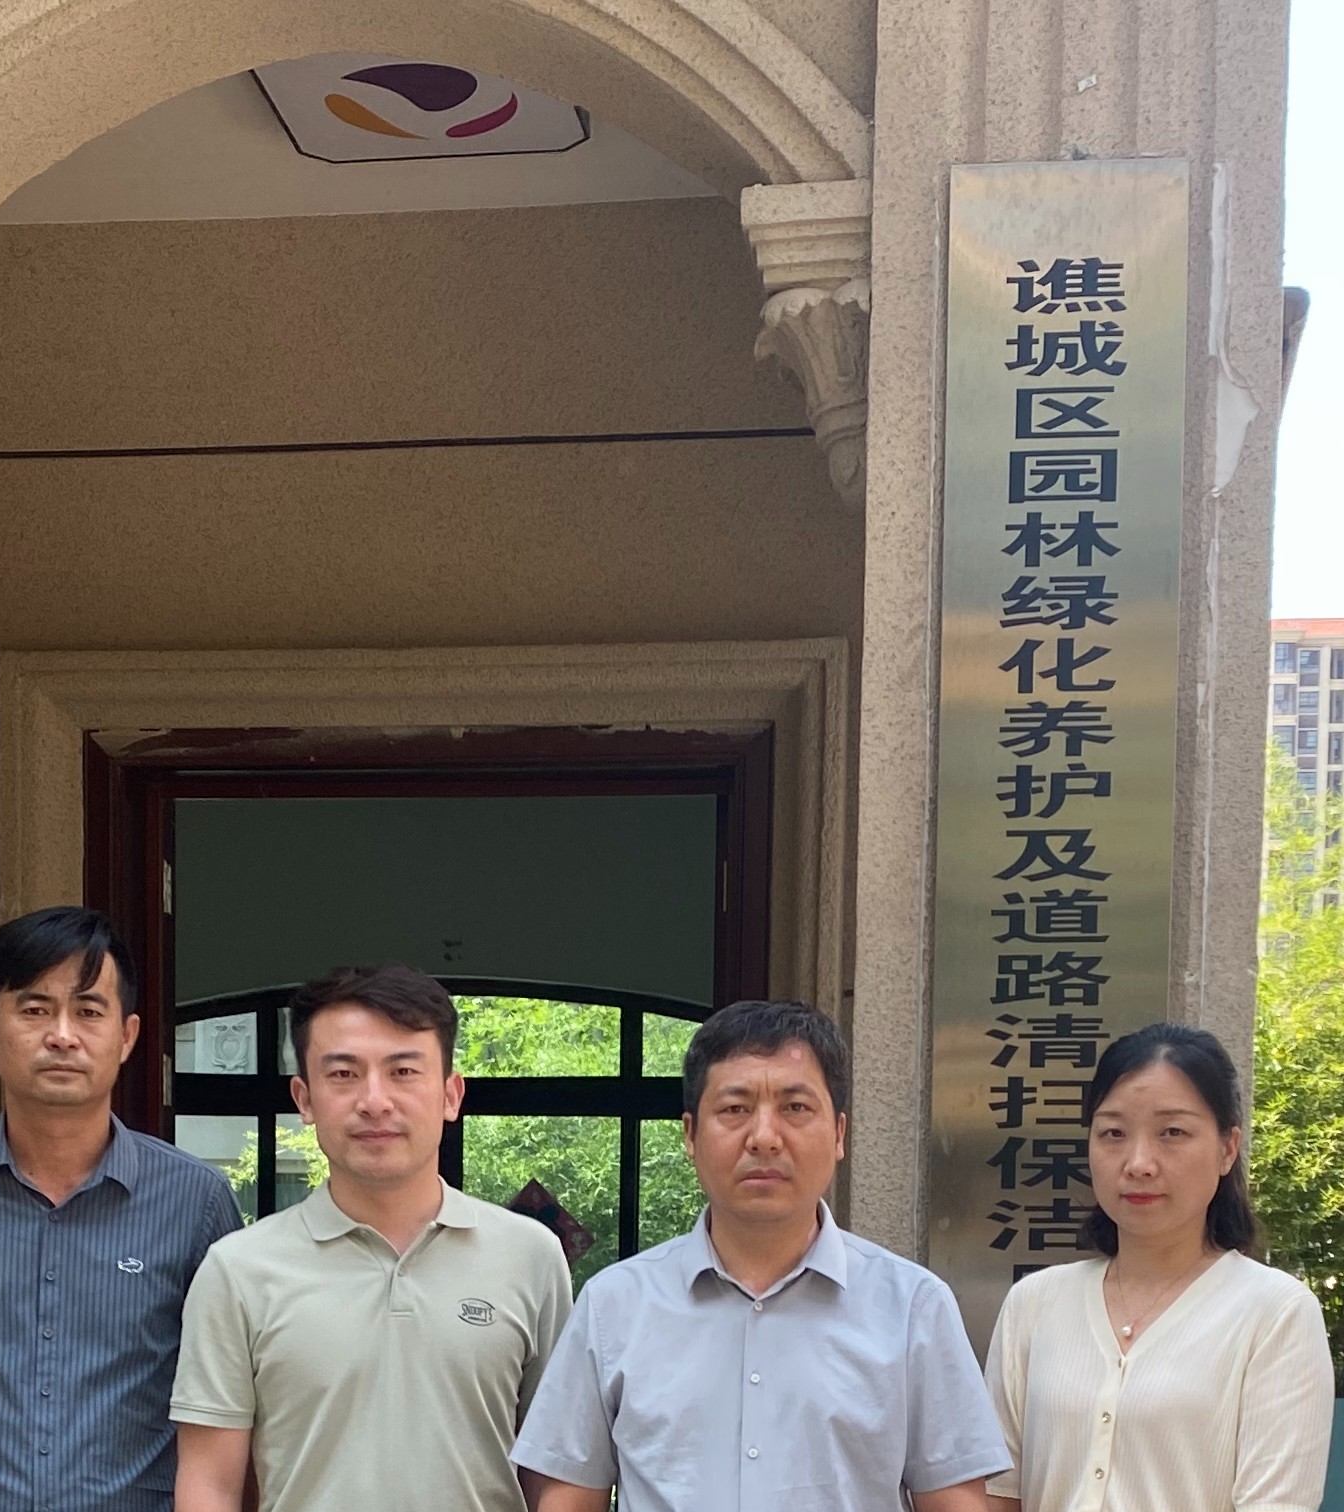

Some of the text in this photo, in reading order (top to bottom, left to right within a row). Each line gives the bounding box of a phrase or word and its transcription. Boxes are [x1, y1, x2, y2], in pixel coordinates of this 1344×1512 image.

[986, 257, 1127, 1284] 谯城区园林绿化养护及道路清扫保洁
